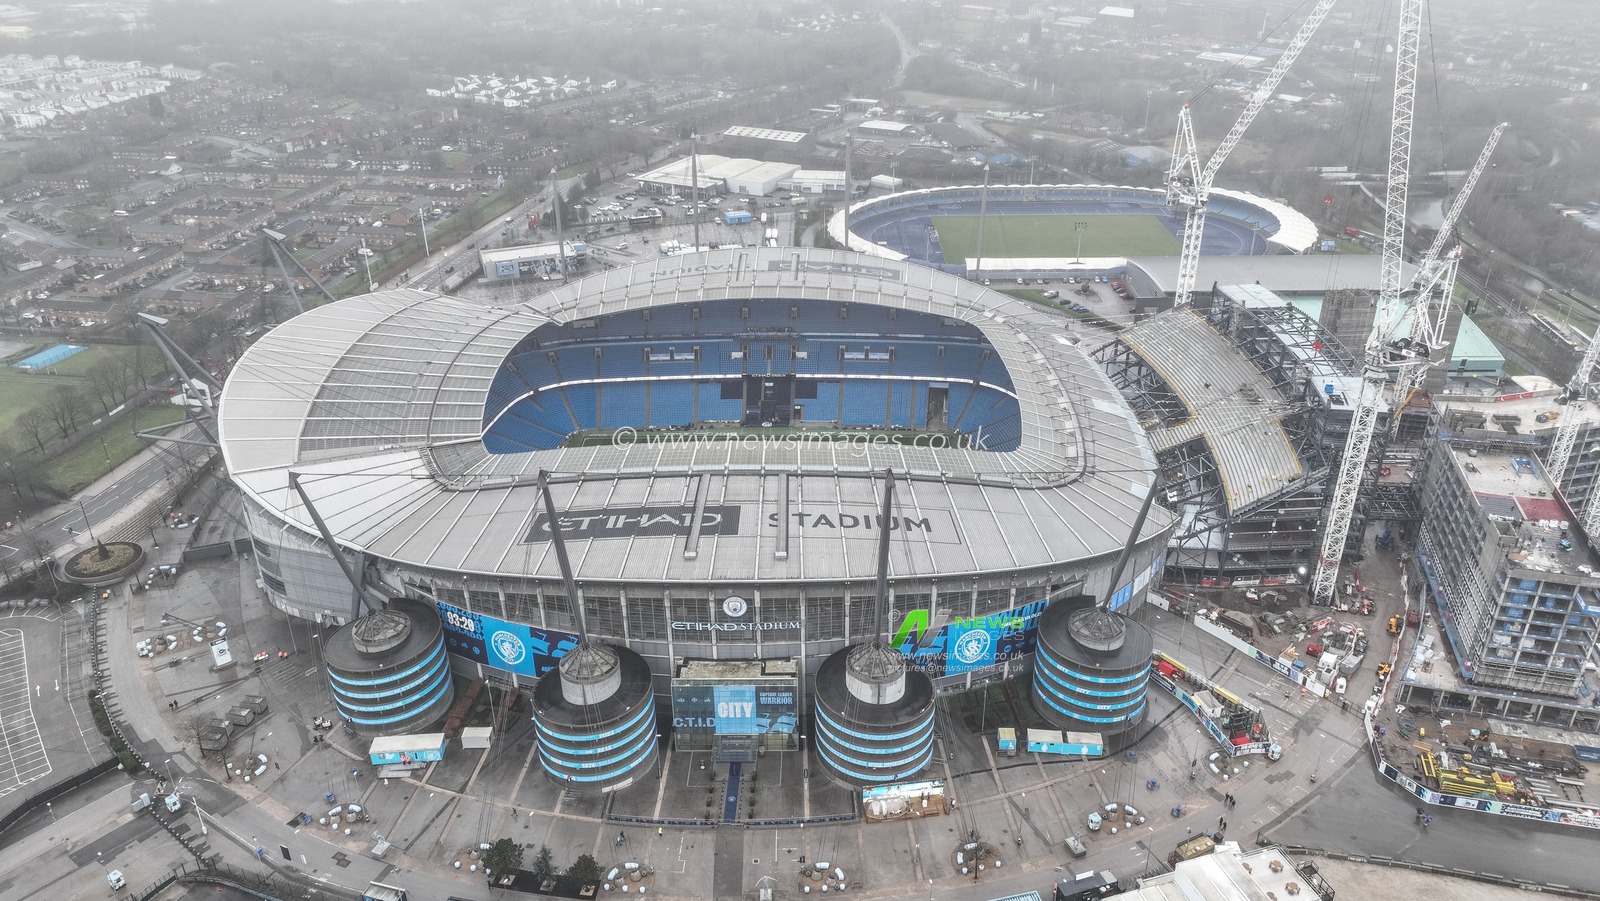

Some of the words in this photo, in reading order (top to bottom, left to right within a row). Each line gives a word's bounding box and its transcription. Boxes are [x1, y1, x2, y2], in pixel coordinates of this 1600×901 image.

[541, 513, 723, 531] ETIHAD
[768, 512, 932, 532] STADIUM
[672, 621, 738, 631] ETIHAD
[741, 621, 800, 631] STADIUM
[760, 696, 793, 705] WARRIOR
[717, 702, 753, 718] CITY
